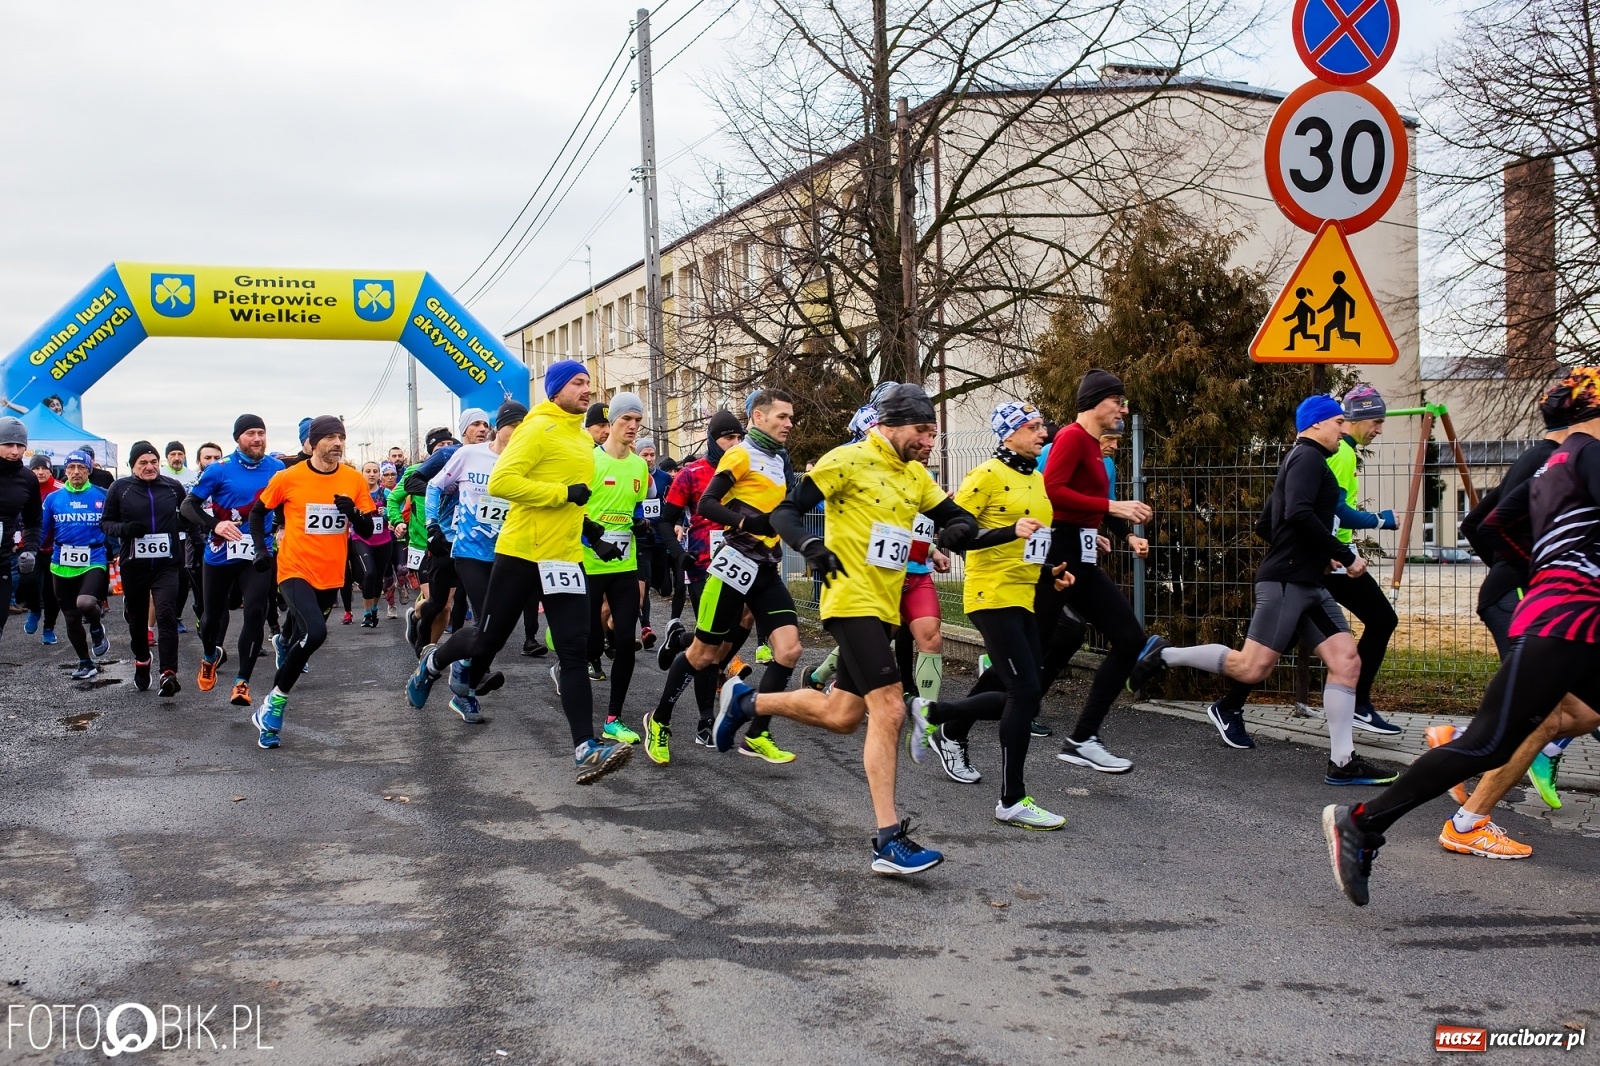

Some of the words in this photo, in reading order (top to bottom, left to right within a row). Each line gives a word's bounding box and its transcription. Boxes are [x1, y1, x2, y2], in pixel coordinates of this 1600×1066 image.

[1289, 116, 1385, 195] 30
[234, 275, 316, 289] Gmina
[213, 290, 338, 307] Pietrowice
[229, 308, 321, 324] Wielkie
[29, 323, 80, 366] Gmina
[74, 286, 118, 326] ludzi
[425, 297, 469, 341] Gmina
[467, 335, 505, 372] ludzi
[50, 306, 133, 380] aktywnych
[413, 314, 488, 385] aktywnych
[644, 505, 659, 514] 98
[307, 514, 346, 529] 205
[137, 541, 169, 554] 366
[874, 538, 909, 564] 130
[62, 552, 89, 563] 150
[545, 571, 582, 588] 151
[712, 556, 752, 586] 259
